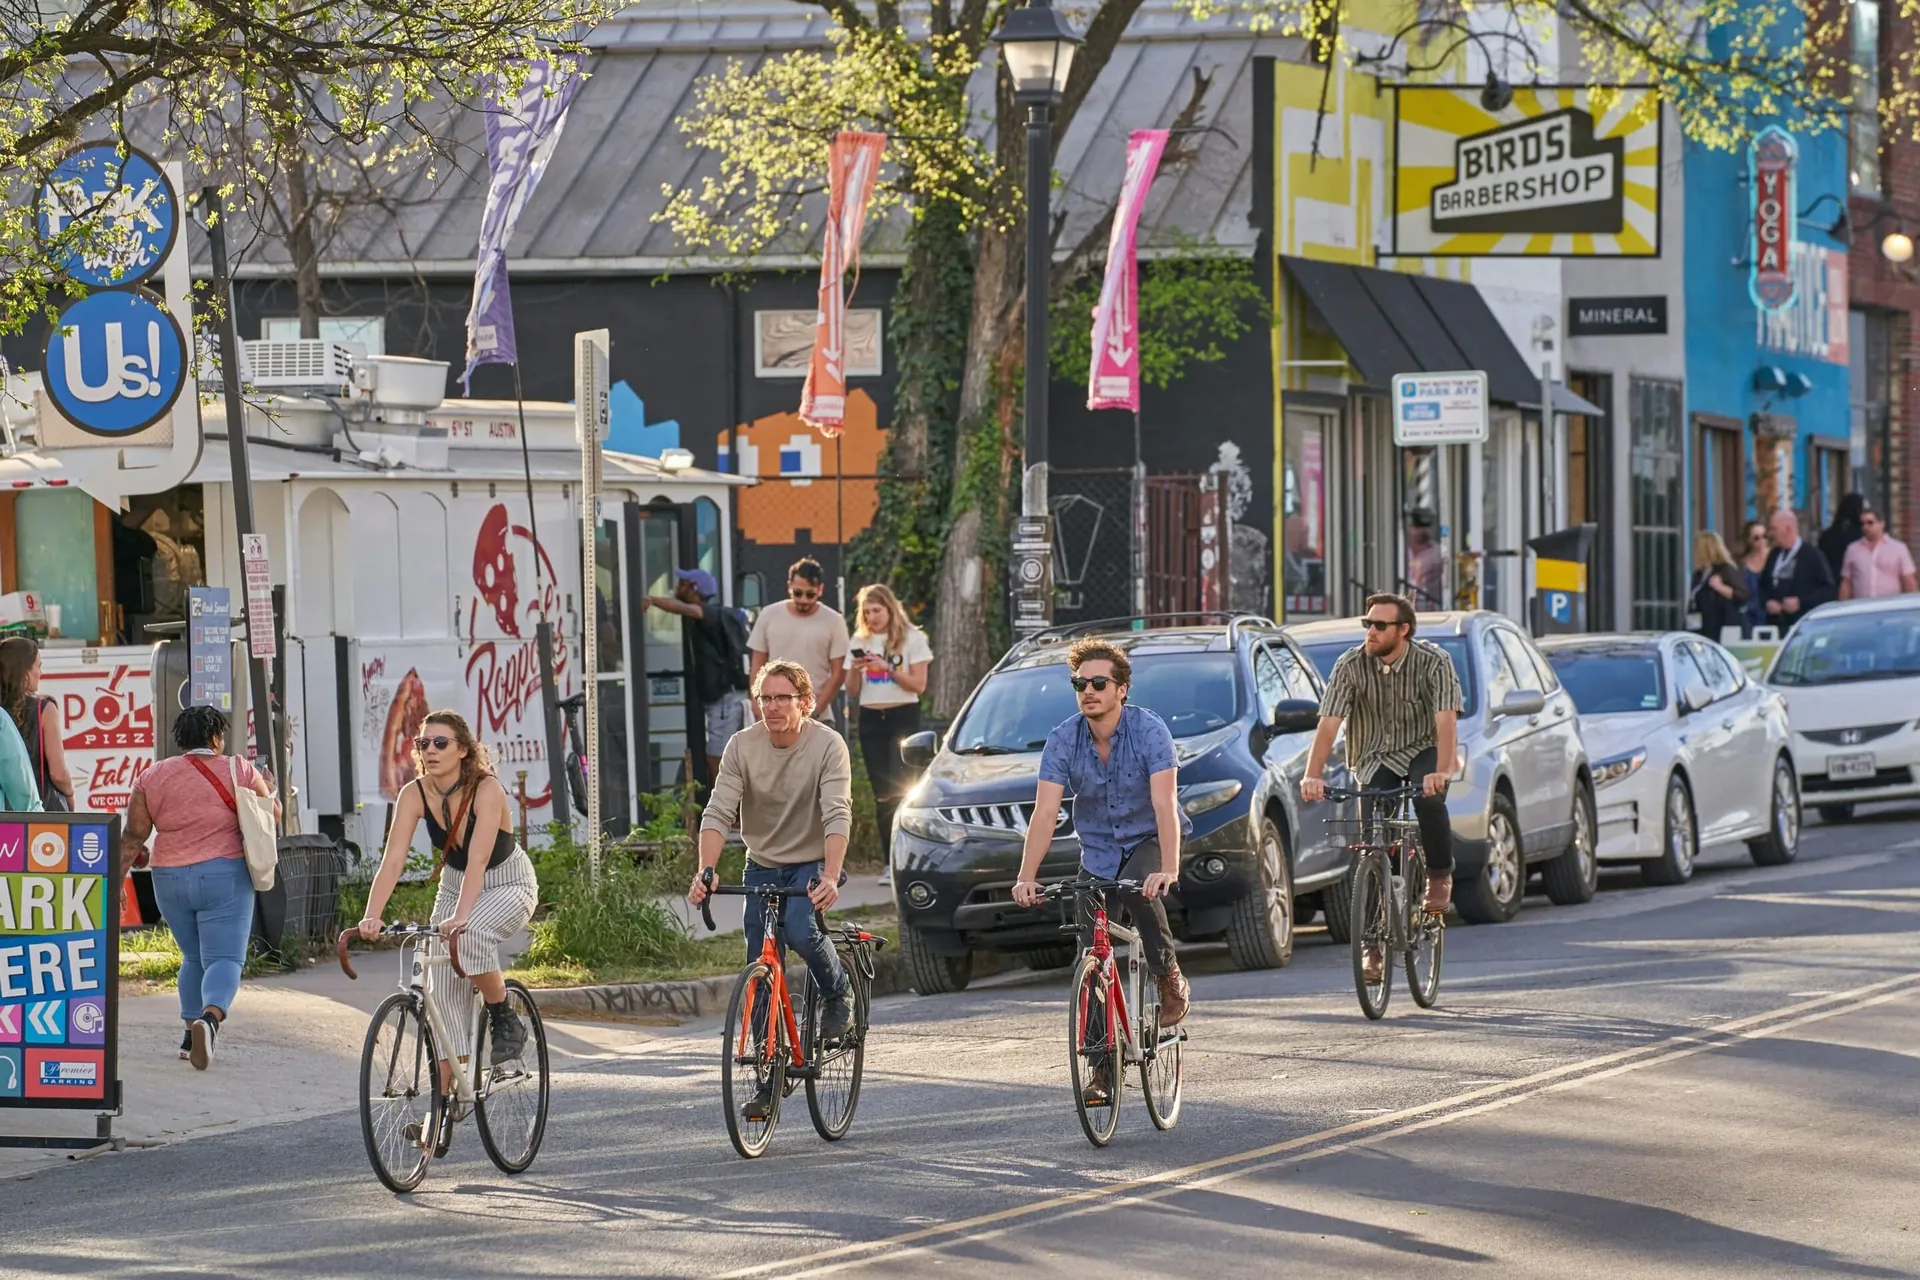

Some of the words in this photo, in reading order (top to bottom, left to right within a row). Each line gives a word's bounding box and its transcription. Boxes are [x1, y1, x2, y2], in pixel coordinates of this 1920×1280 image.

[1463, 124, 1565, 180] BIRDS
[1440, 165, 1606, 212] BARBERSHOP
[1758, 173, 1781, 268] YOGA
[1579, 308, 1658, 325] MINERAL
[62, 320, 162, 403] Us!
[464, 421, 473, 437] ST
[489, 422, 516, 438] AUSTIN
[1551, 592, 1568, 618] P
[205, 664, 220, 672] VEHICLE
[85, 734, 154, 745] PIZZ
[89, 756, 131, 791] Eat
[91, 796, 106, 806] WE
[107, 796, 126, 806] CAN
